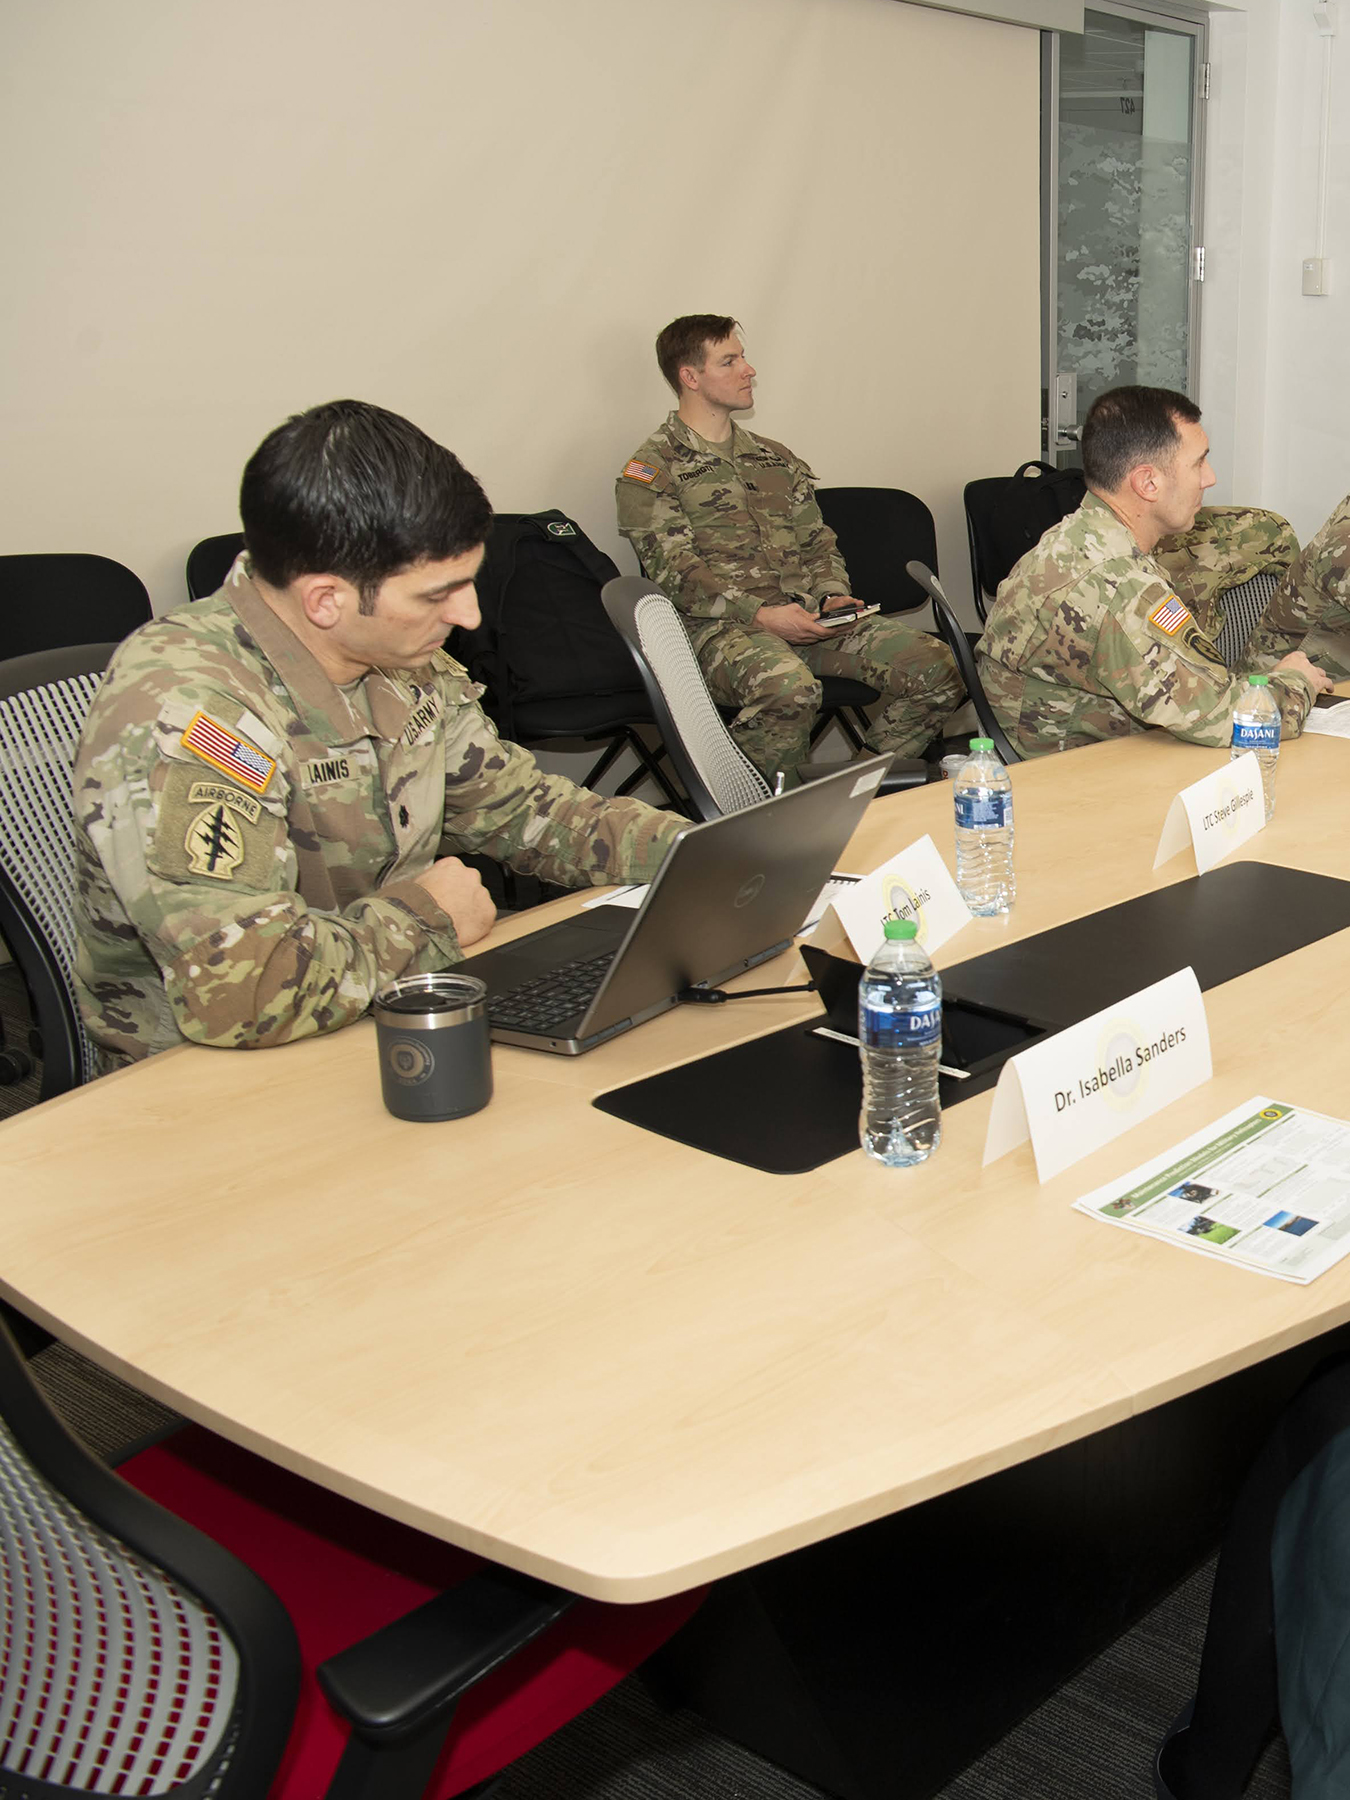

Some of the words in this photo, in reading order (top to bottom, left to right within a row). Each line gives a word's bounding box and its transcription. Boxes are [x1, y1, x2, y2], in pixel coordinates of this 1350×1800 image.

[1240, 728, 1275, 740] DASANI
[195, 787, 257, 816] AIRBORNE
[1202, 815, 1214, 831] LTC
[1213, 805, 1231, 824] Steve
[893, 904, 912, 920] Tom
[907, 888, 931, 911] Lainis
[1054, 1090, 1077, 1112] Dr.
[1079, 1056, 1133, 1099] Isabella
[1135, 1026, 1187, 1067] Sanders
